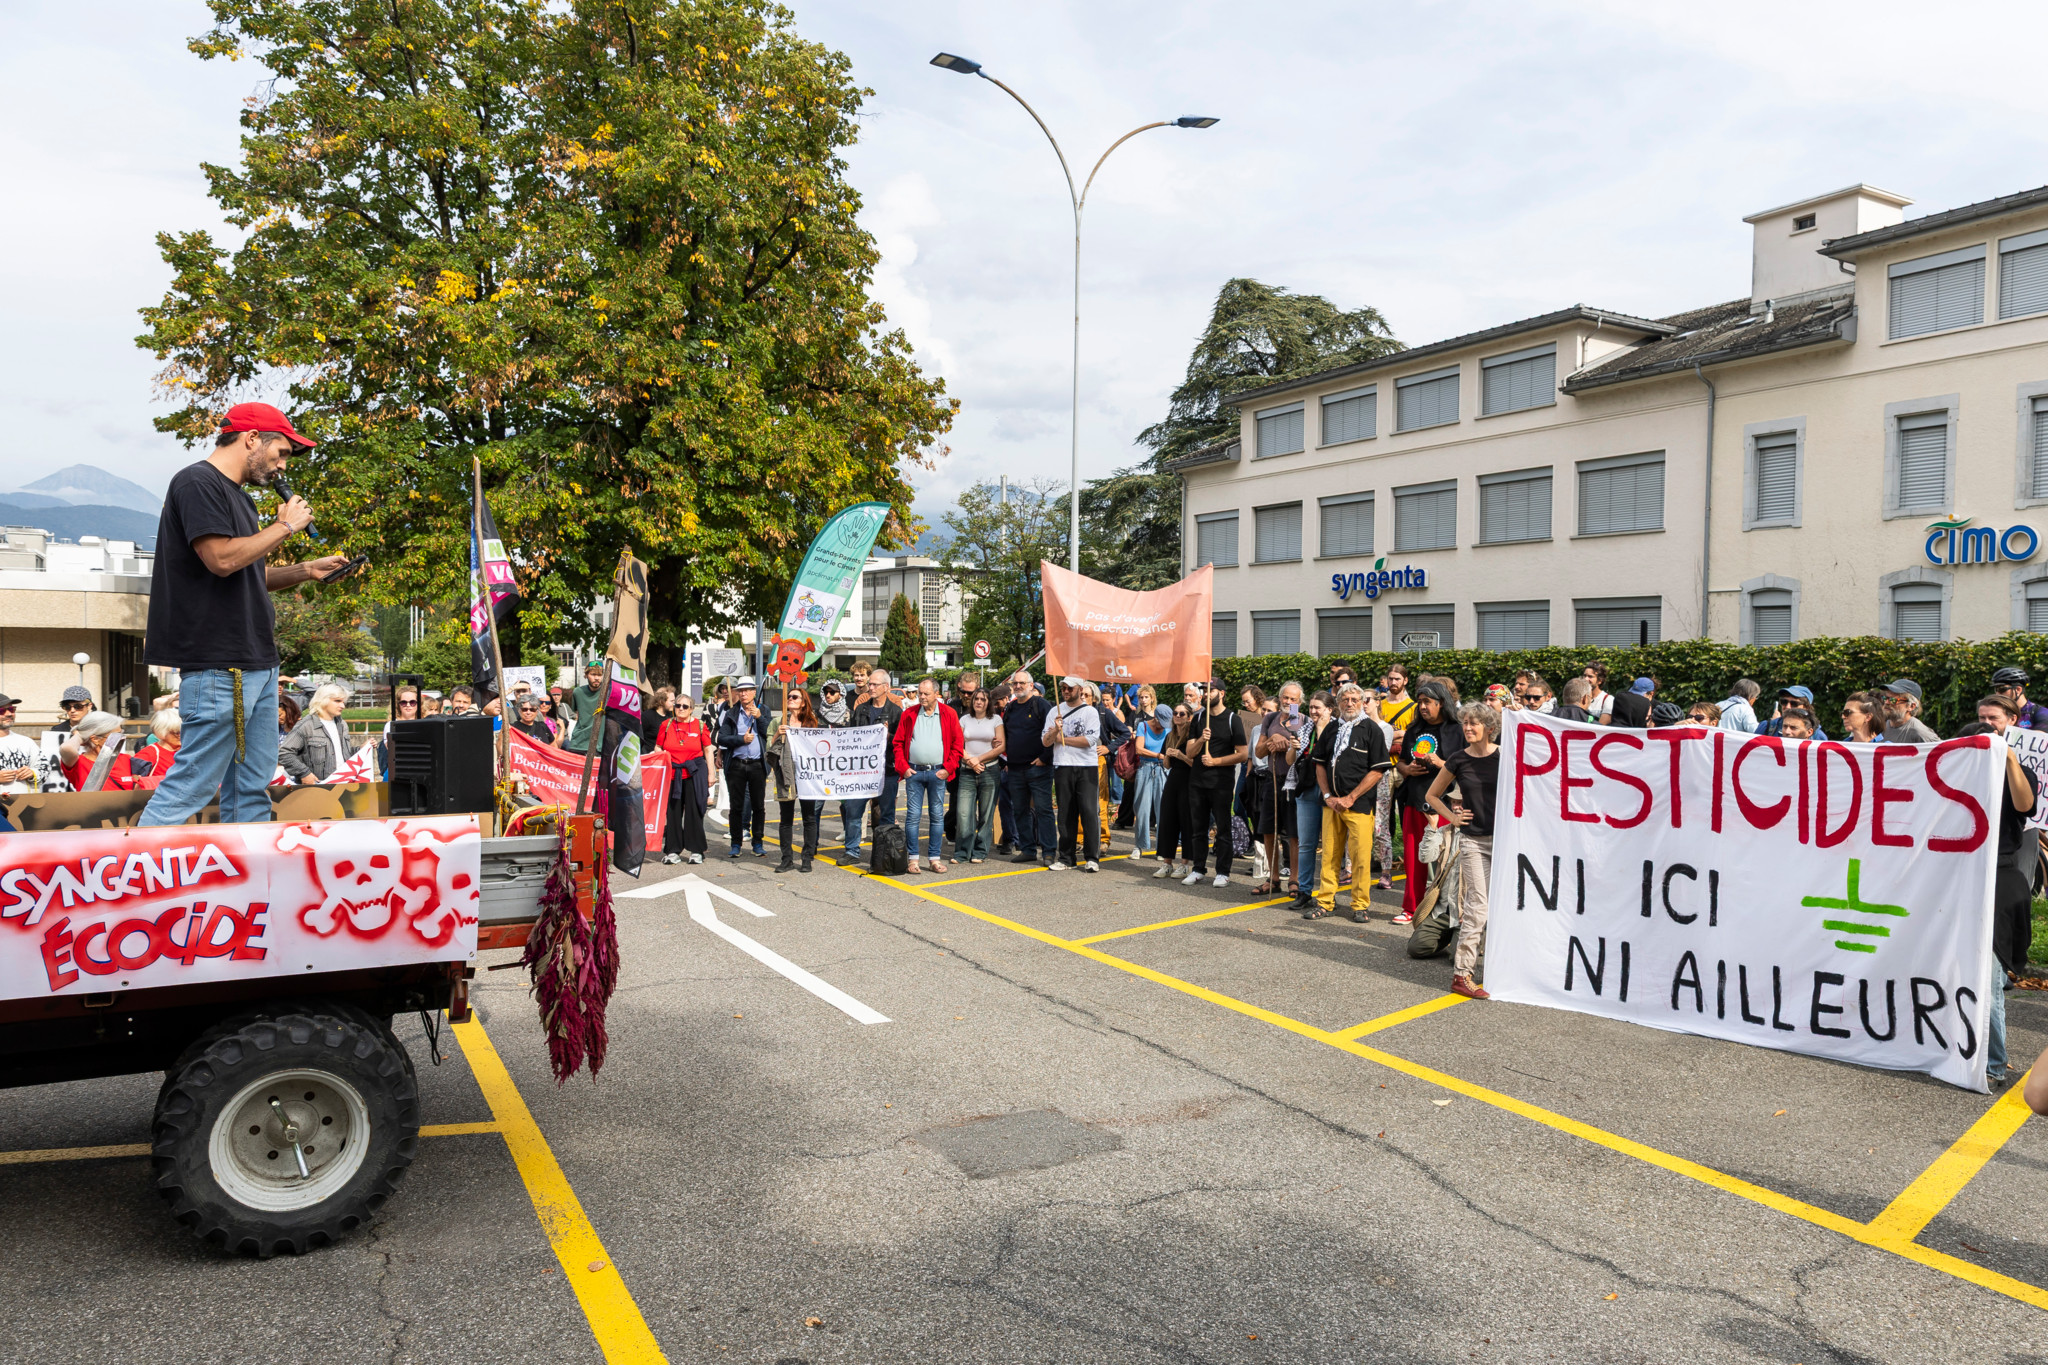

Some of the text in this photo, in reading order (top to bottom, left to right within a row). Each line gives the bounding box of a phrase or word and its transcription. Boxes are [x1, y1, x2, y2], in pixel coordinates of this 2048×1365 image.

[814, 556, 856, 572] pour le Climat
[816, 546, 861, 564] Grands-Parents
[1331, 564, 1426, 600] syngenta
[1085, 611, 1161, 624] pas d'avenir
[1093, 621, 1177, 637] décroissance
[1104, 660, 1133, 678] da.
[804, 729, 825, 737] TERRE
[831, 729, 847, 737] AUX
[514, 752, 567, 778] Business
[799, 753, 879, 772] uniterre
[824, 778, 836, 786] LES
[835, 782, 879, 794] PAYSANNES
[1514, 723, 1991, 852] PESTICIDES
[0, 843, 240, 926] SYNGENTA
[1517, 853, 1719, 927] NI ICI
[1564, 936, 1978, 1060] NI AILLEURS
